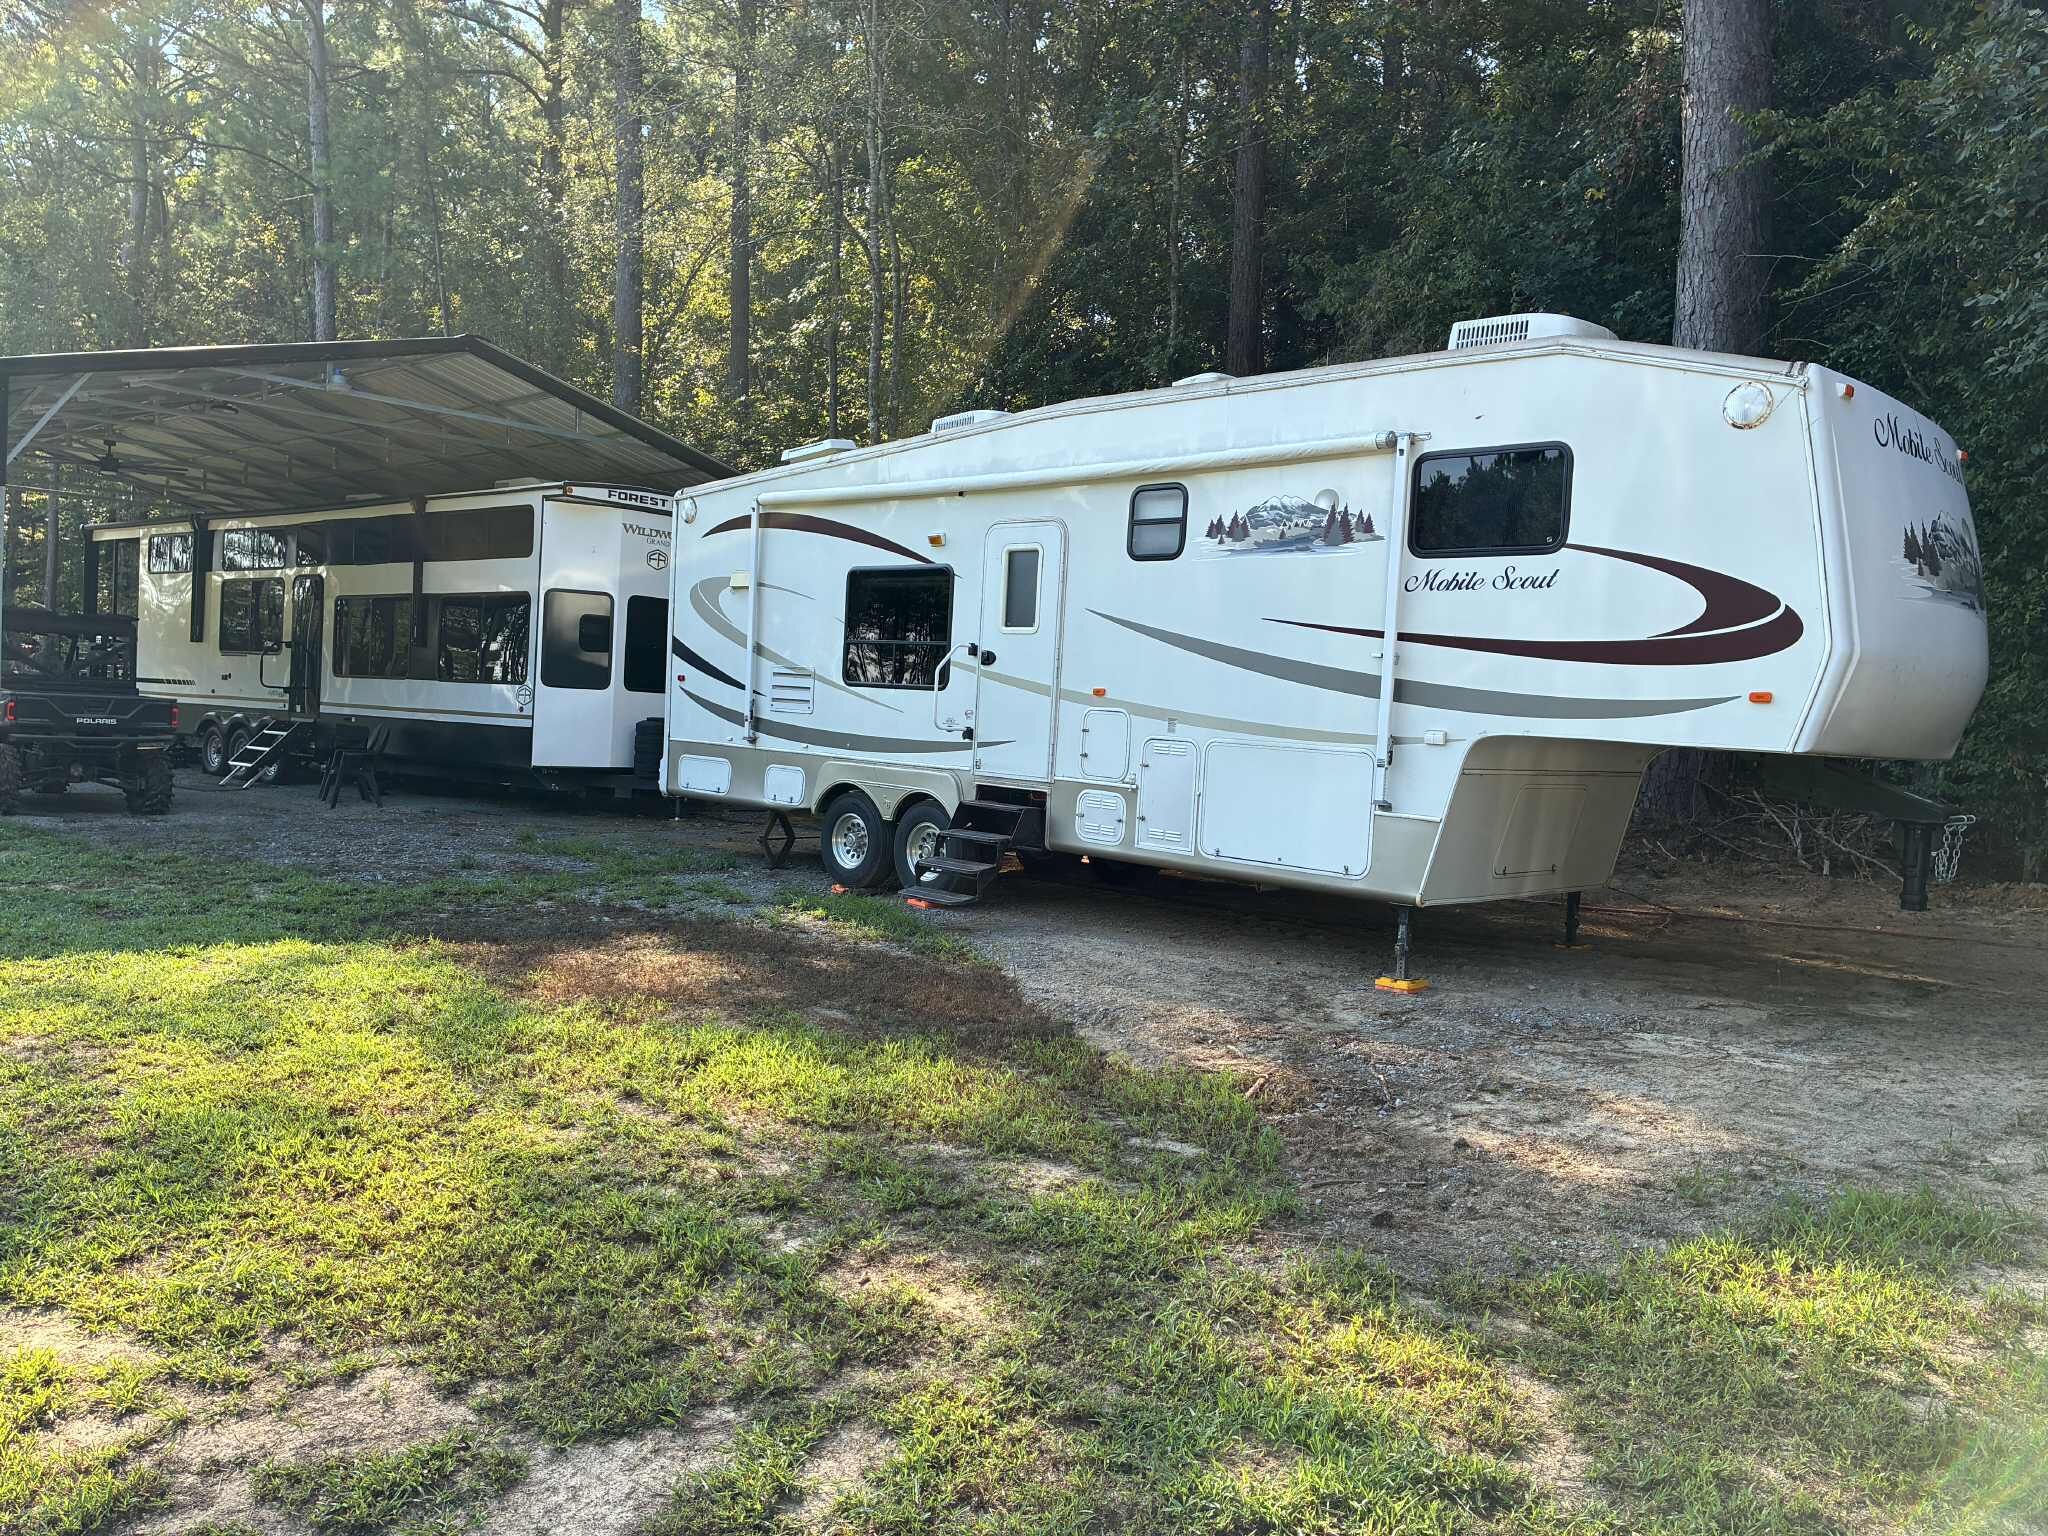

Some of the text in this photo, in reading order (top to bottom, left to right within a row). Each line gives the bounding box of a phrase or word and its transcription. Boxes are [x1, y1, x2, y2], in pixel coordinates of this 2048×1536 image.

[1874, 412, 1934, 465] Mobile
[608, 490, 668, 507] FOREST
[1404, 565, 1561, 593] Mobile Scout
[76, 717, 117, 725] POLARIS
